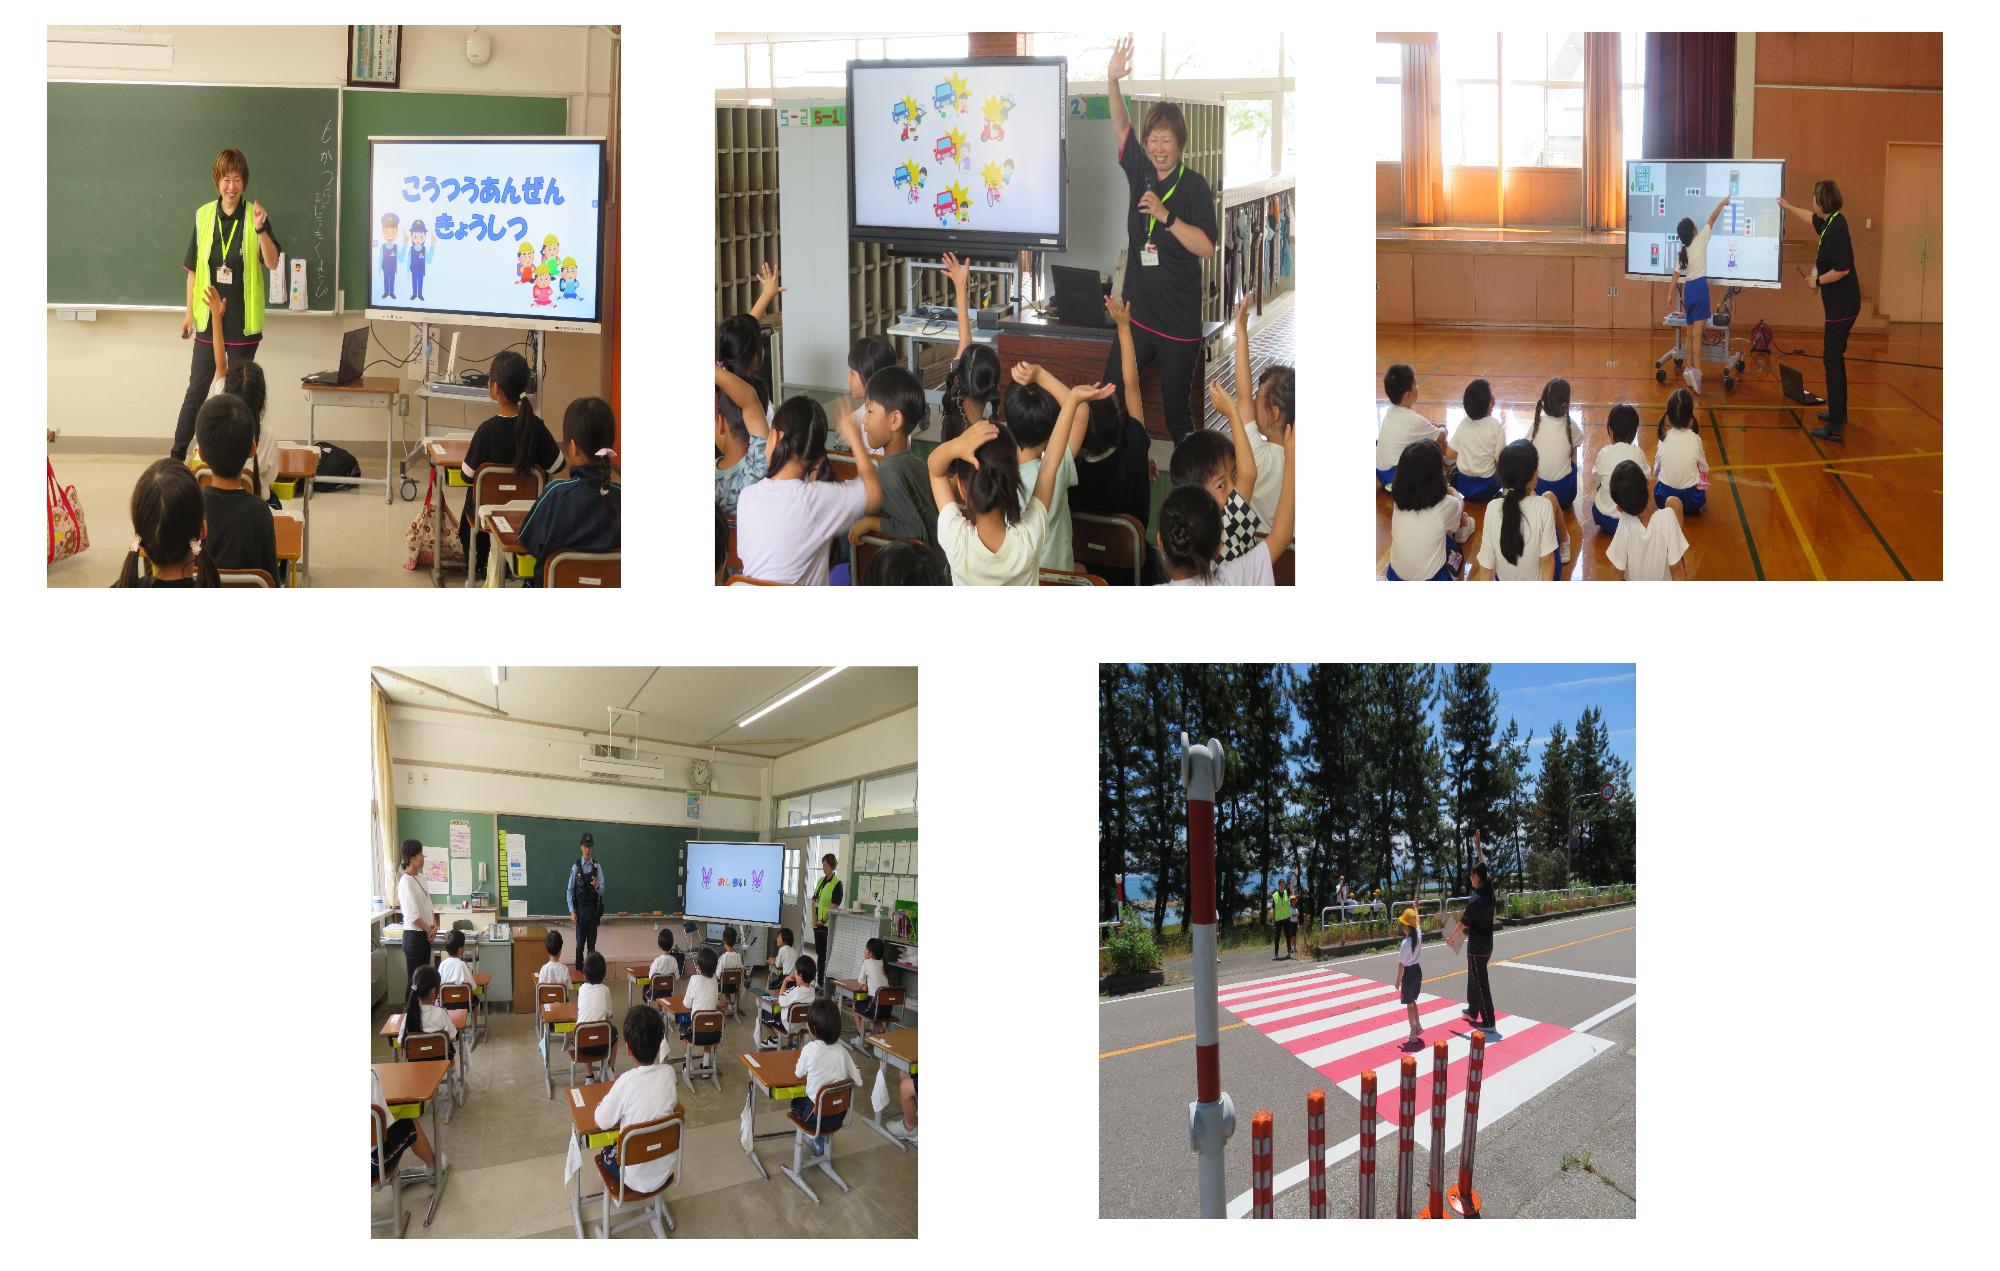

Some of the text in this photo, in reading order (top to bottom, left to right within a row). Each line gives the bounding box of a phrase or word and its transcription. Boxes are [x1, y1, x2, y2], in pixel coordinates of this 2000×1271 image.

[402, 175, 566, 206] こうつうあんぜん
[434, 212, 529, 242] きょうしつ
